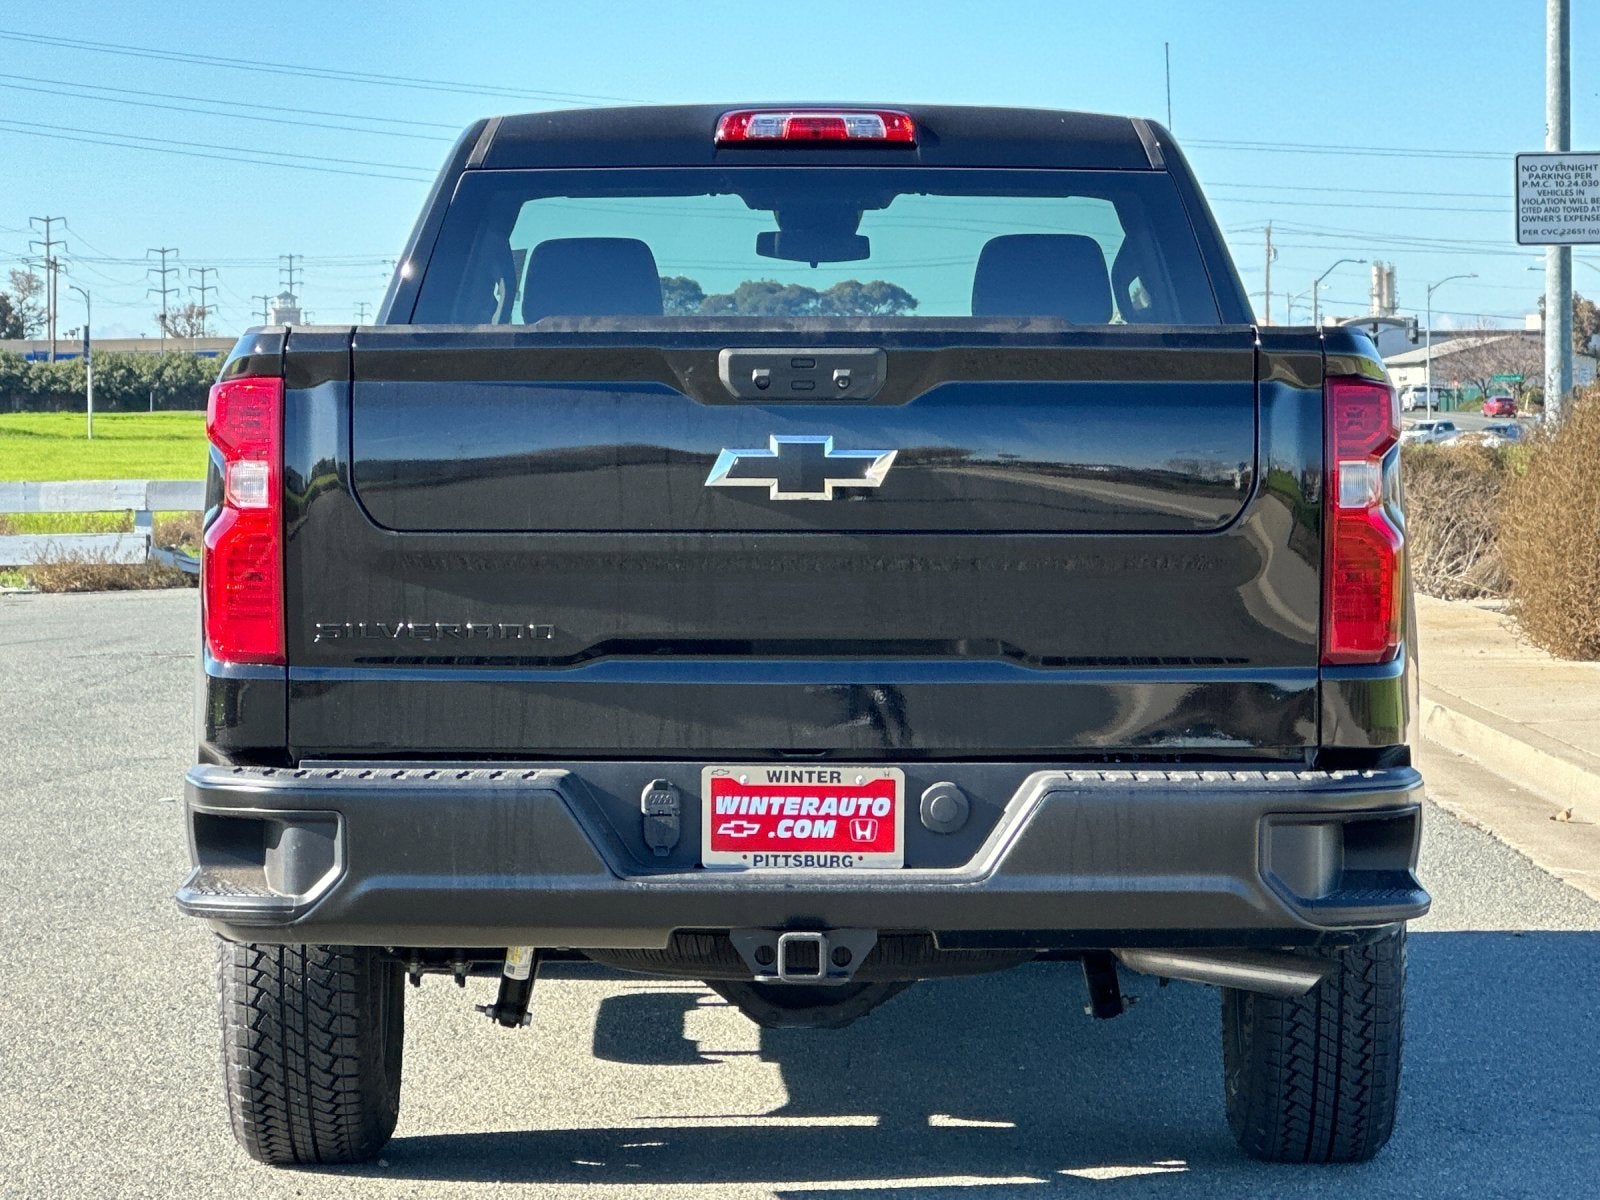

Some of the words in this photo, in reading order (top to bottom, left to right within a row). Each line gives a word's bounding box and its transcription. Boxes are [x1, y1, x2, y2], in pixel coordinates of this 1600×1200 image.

[1540, 164, 1598, 172] OVERNIGHT
[313, 622, 555, 641] SILVERADO
[767, 770, 841, 784] WINTER
[715, 796, 891, 817] WINTERAUTO
[767, 819, 837, 839] .COM
[753, 854, 853, 868] PITTSBURG
